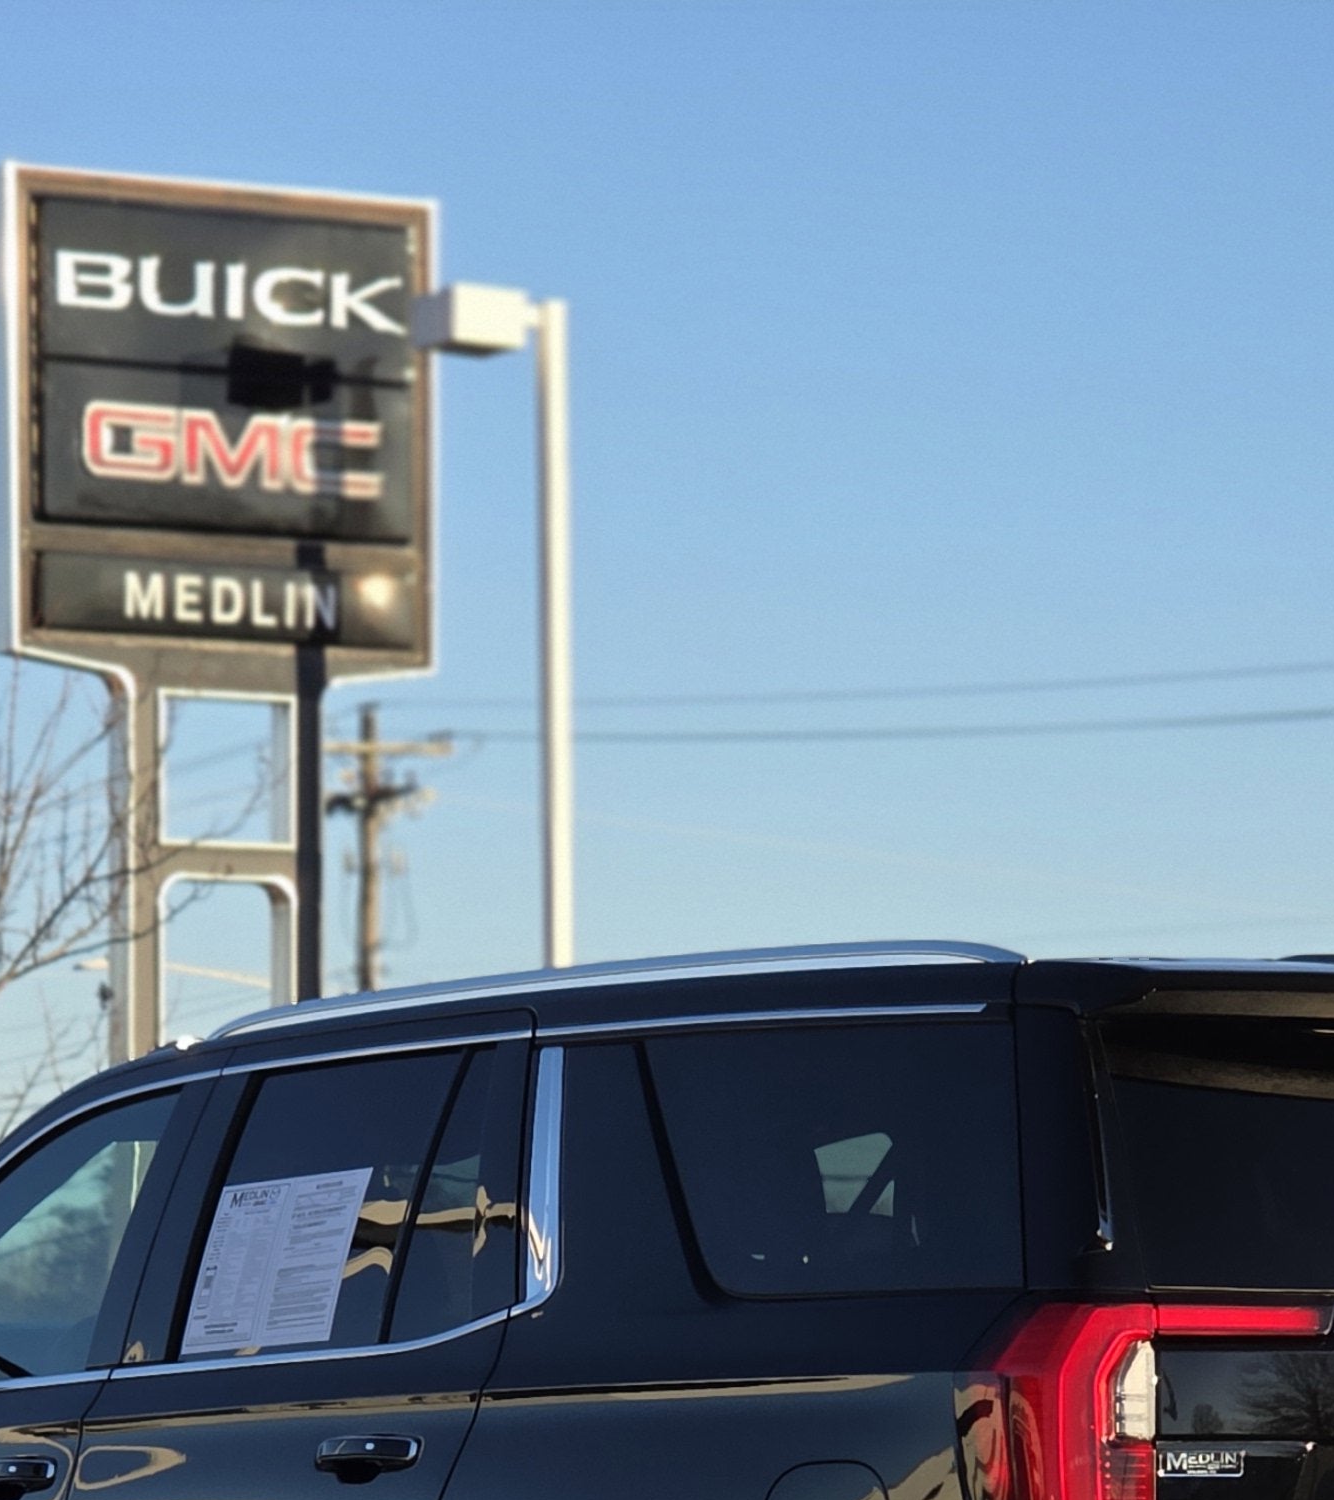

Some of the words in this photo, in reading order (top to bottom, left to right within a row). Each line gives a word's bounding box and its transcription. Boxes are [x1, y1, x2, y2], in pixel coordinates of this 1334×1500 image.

[56, 250, 408, 336] BUICK
[83, 401, 385, 498] GMC
[124, 571, 337, 630] MEDLIN
